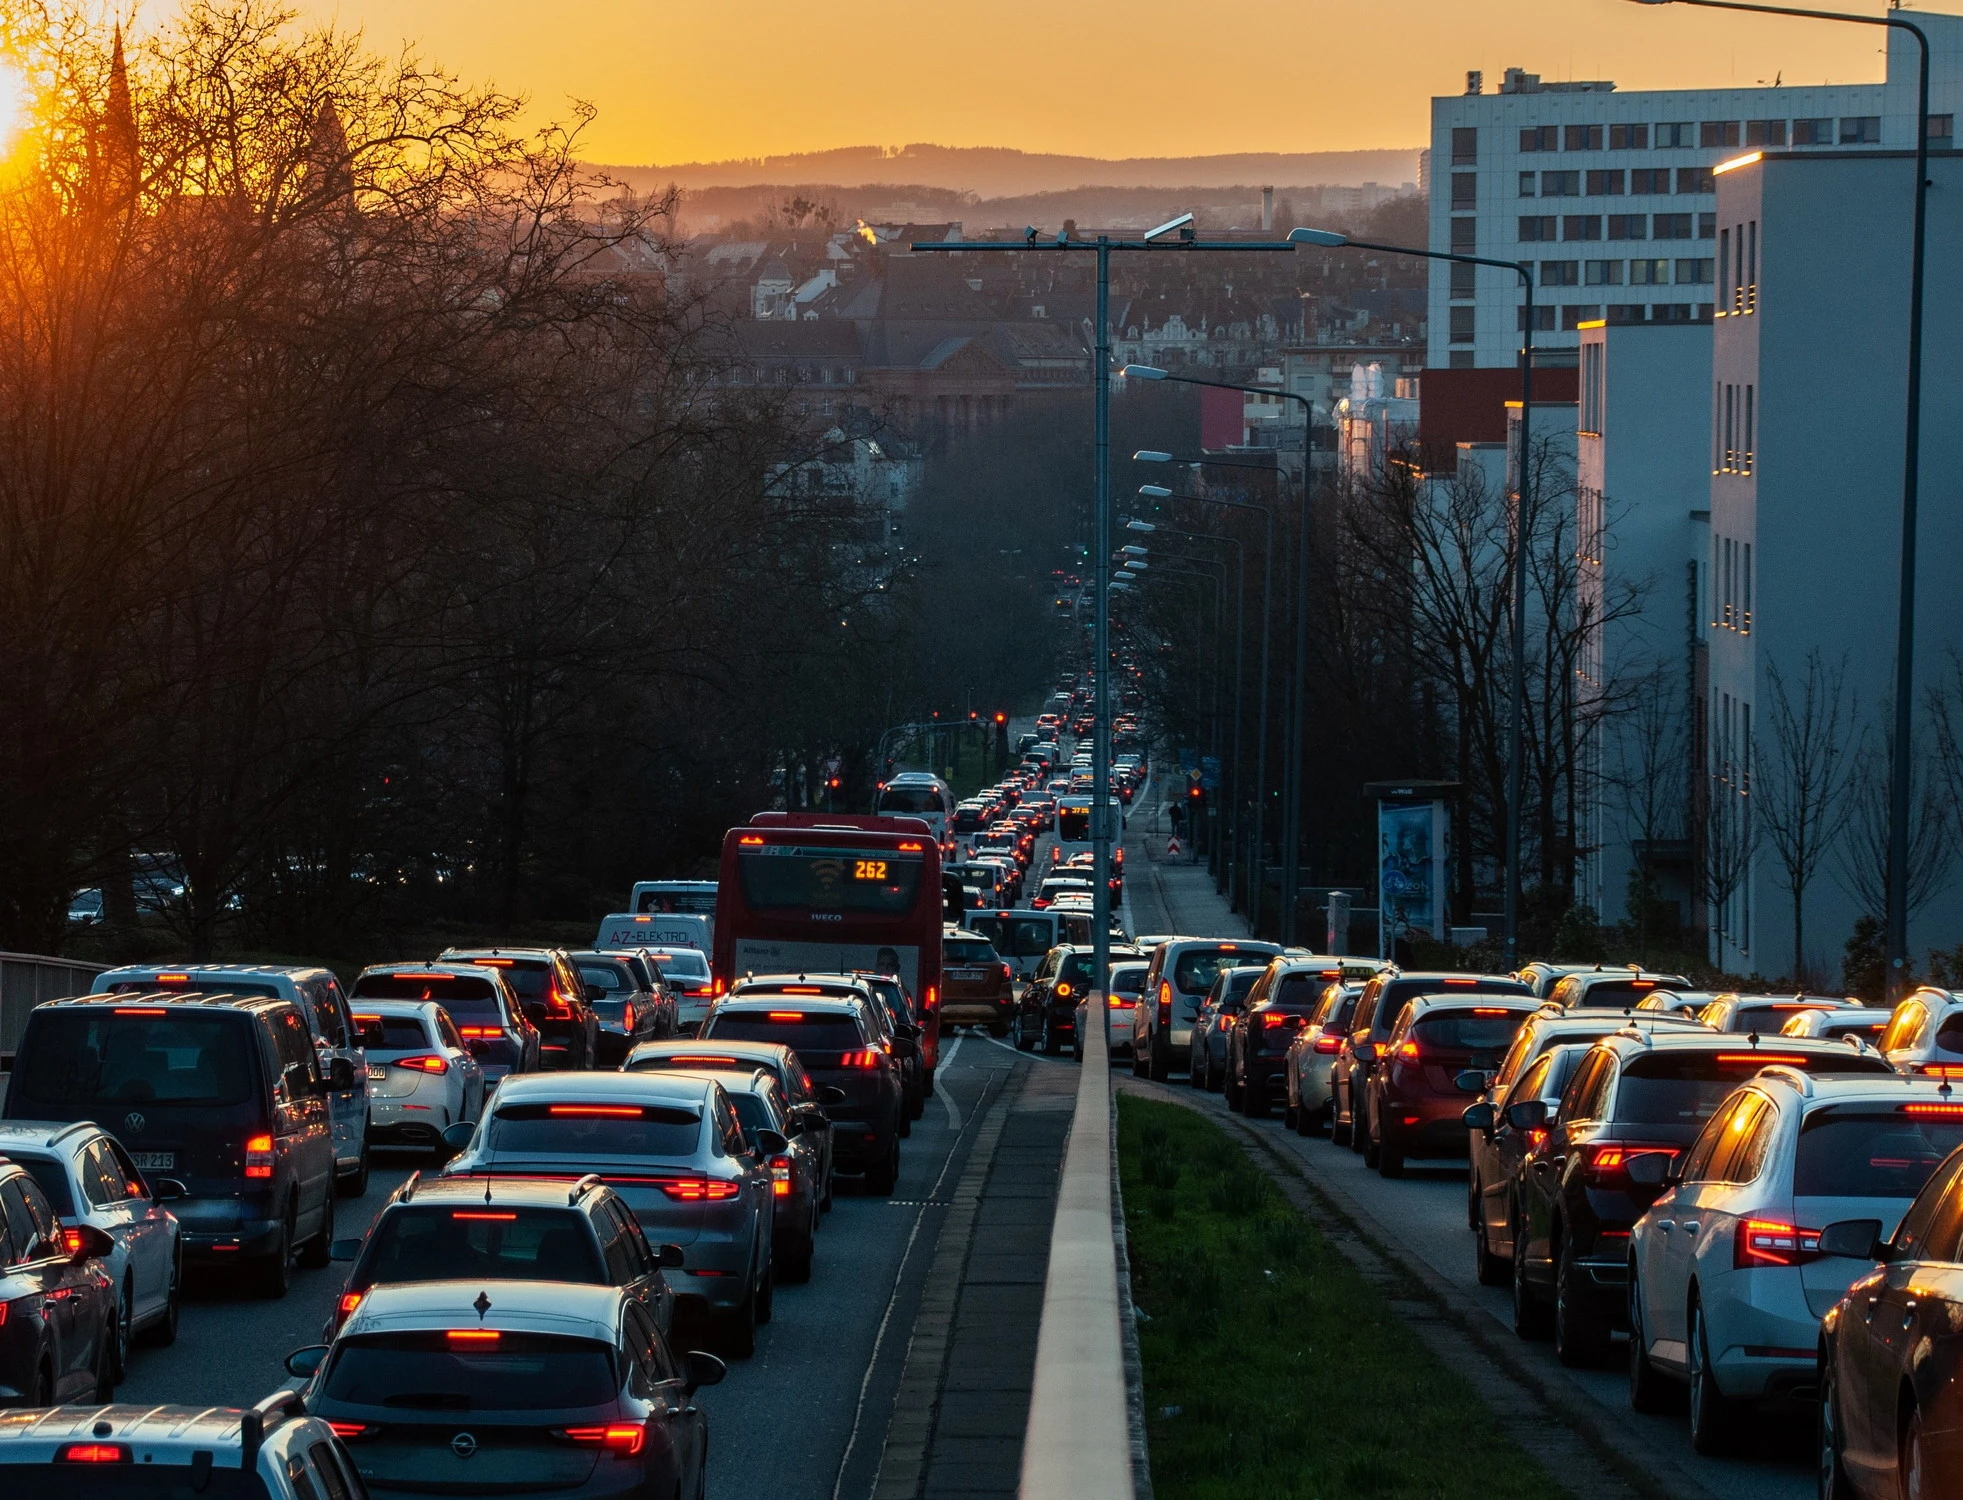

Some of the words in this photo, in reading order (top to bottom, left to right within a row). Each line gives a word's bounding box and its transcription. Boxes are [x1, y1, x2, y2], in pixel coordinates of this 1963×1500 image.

[854, 860, 887, 880] 262
[811, 913, 842, 922] IVECO
[610, 931, 687, 945] AZ-ELEKTRO
[1345, 967, 1369, 977] TAXI
[150, 1154, 172, 1167] 213
